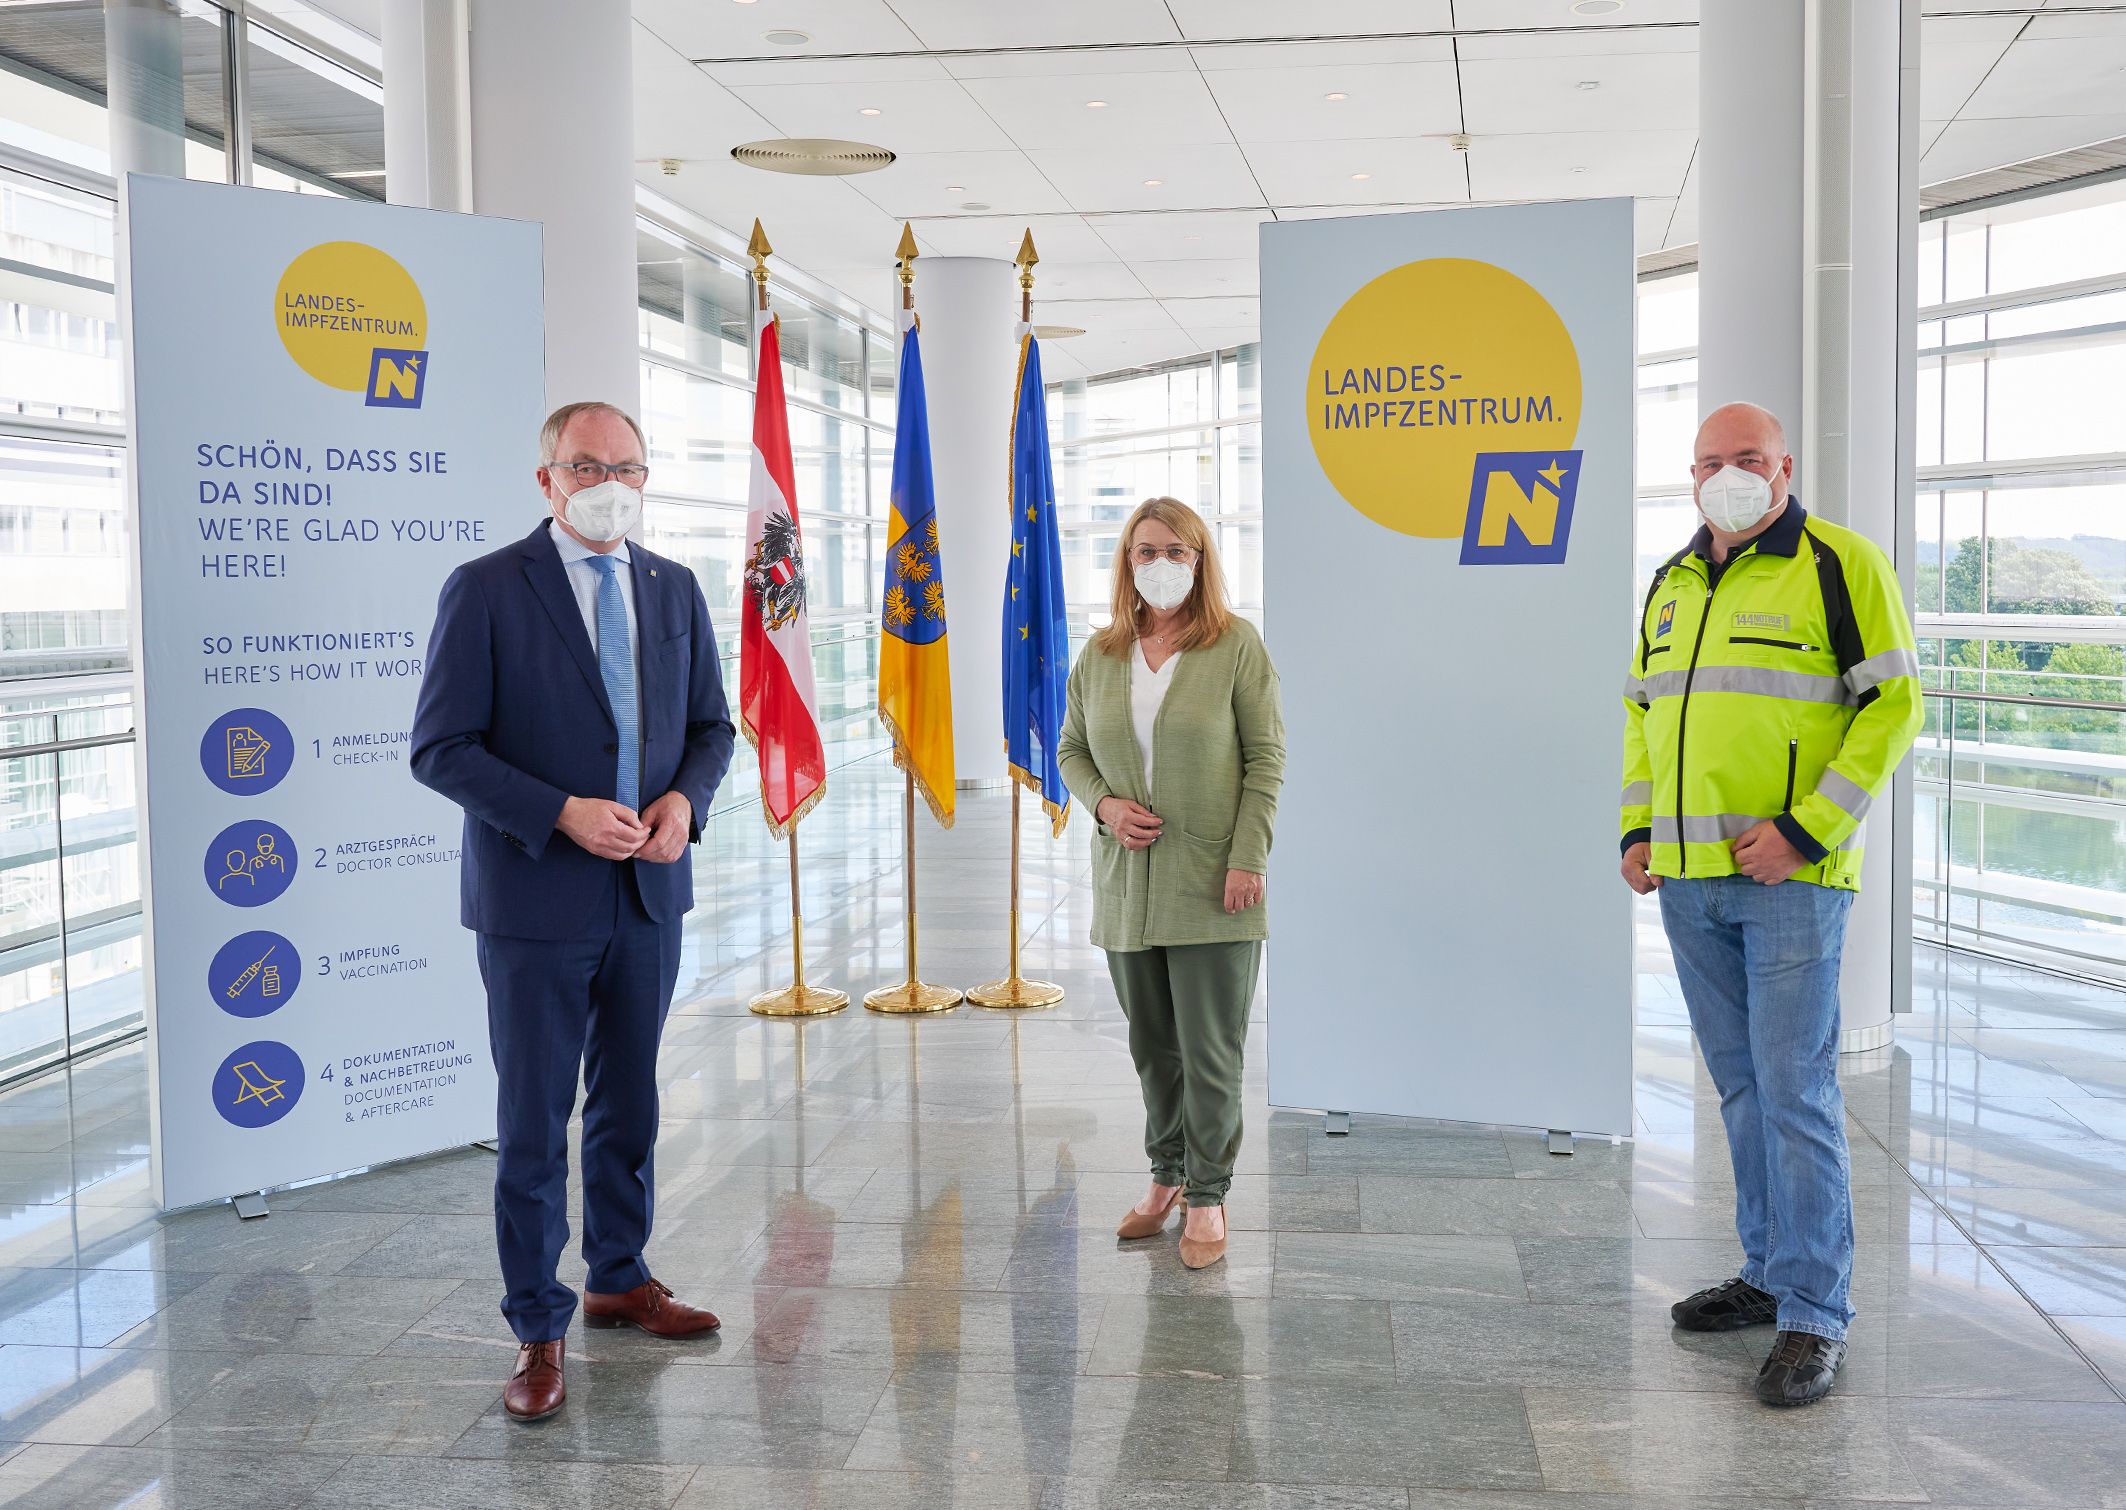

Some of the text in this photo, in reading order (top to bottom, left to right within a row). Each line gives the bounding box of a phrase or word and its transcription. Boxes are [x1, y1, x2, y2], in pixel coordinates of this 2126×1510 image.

[285, 292, 365, 313] LANDES-
[285, 310, 419, 337] IMPFZENTRUM.
[1324, 363, 1463, 396] LANDES-
[1324, 394, 1563, 431] IMPFZENTRUM.
[197, 439, 448, 475] SCHÖN, DASS SIE
[198, 480, 333, 506] DA SIND!
[197, 517, 486, 542] WE’RE GLAD YOU’RE
[201, 553, 286, 578] HERE!
[203, 636, 233, 655] SO
[289, 661, 341, 682] HOW
[350, 660, 368, 679] IT
[374, 658, 422, 677] WOR
[311, 738, 322, 759] 1
[333, 749, 399, 766] CHECK-IN
[314, 833, 437, 869] 2 ARZTGESPRÄCH
[336, 849, 461, 874] DOCTOR CONSULTA
[317, 944, 401, 976] 3 IMPFUNG
[339, 957, 428, 981] VACCINATION
[320, 1039, 456, 1083] 4 DOKUMENTATION
[344, 1053, 473, 1088] & NACHBETREUUNG
[343, 1073, 456, 1106] DOCUMENTATION
[344, 1094, 435, 1123] & AFTERCARE
